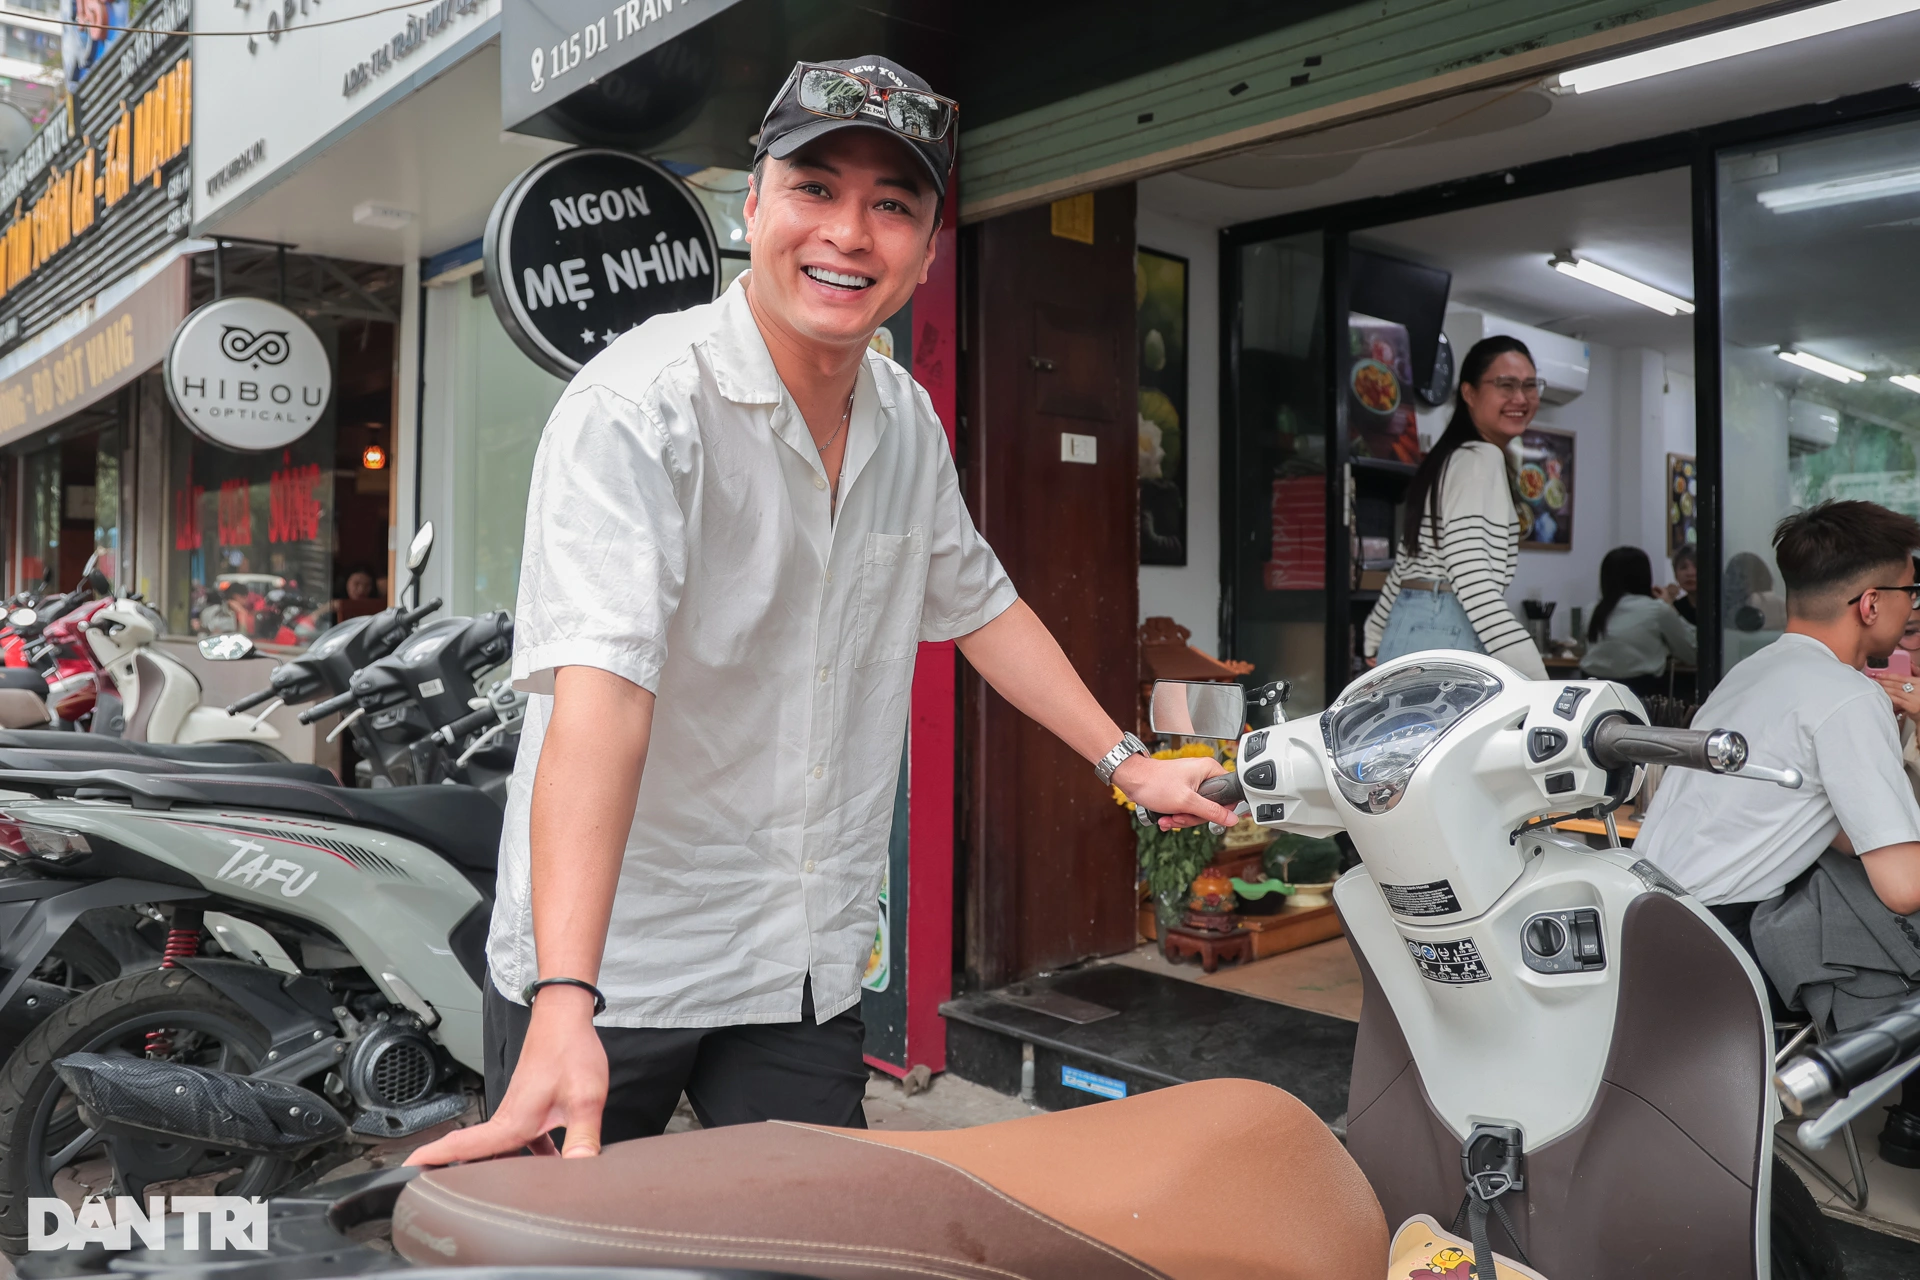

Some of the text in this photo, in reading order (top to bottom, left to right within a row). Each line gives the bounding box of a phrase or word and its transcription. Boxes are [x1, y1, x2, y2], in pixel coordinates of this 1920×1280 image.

[551, 32, 581, 79] 115
[585, 16, 609, 60] D1
[878, 67, 908, 87] YOR
[550, 185, 651, 231] NGON
[523, 231, 711, 311] MẸ NHÍM
[85, 313, 134, 388] VANG
[182, 376, 322, 406] HIBOU
[209, 407, 296, 423] OPTICAL
[214, 838, 319, 898] TAFU
